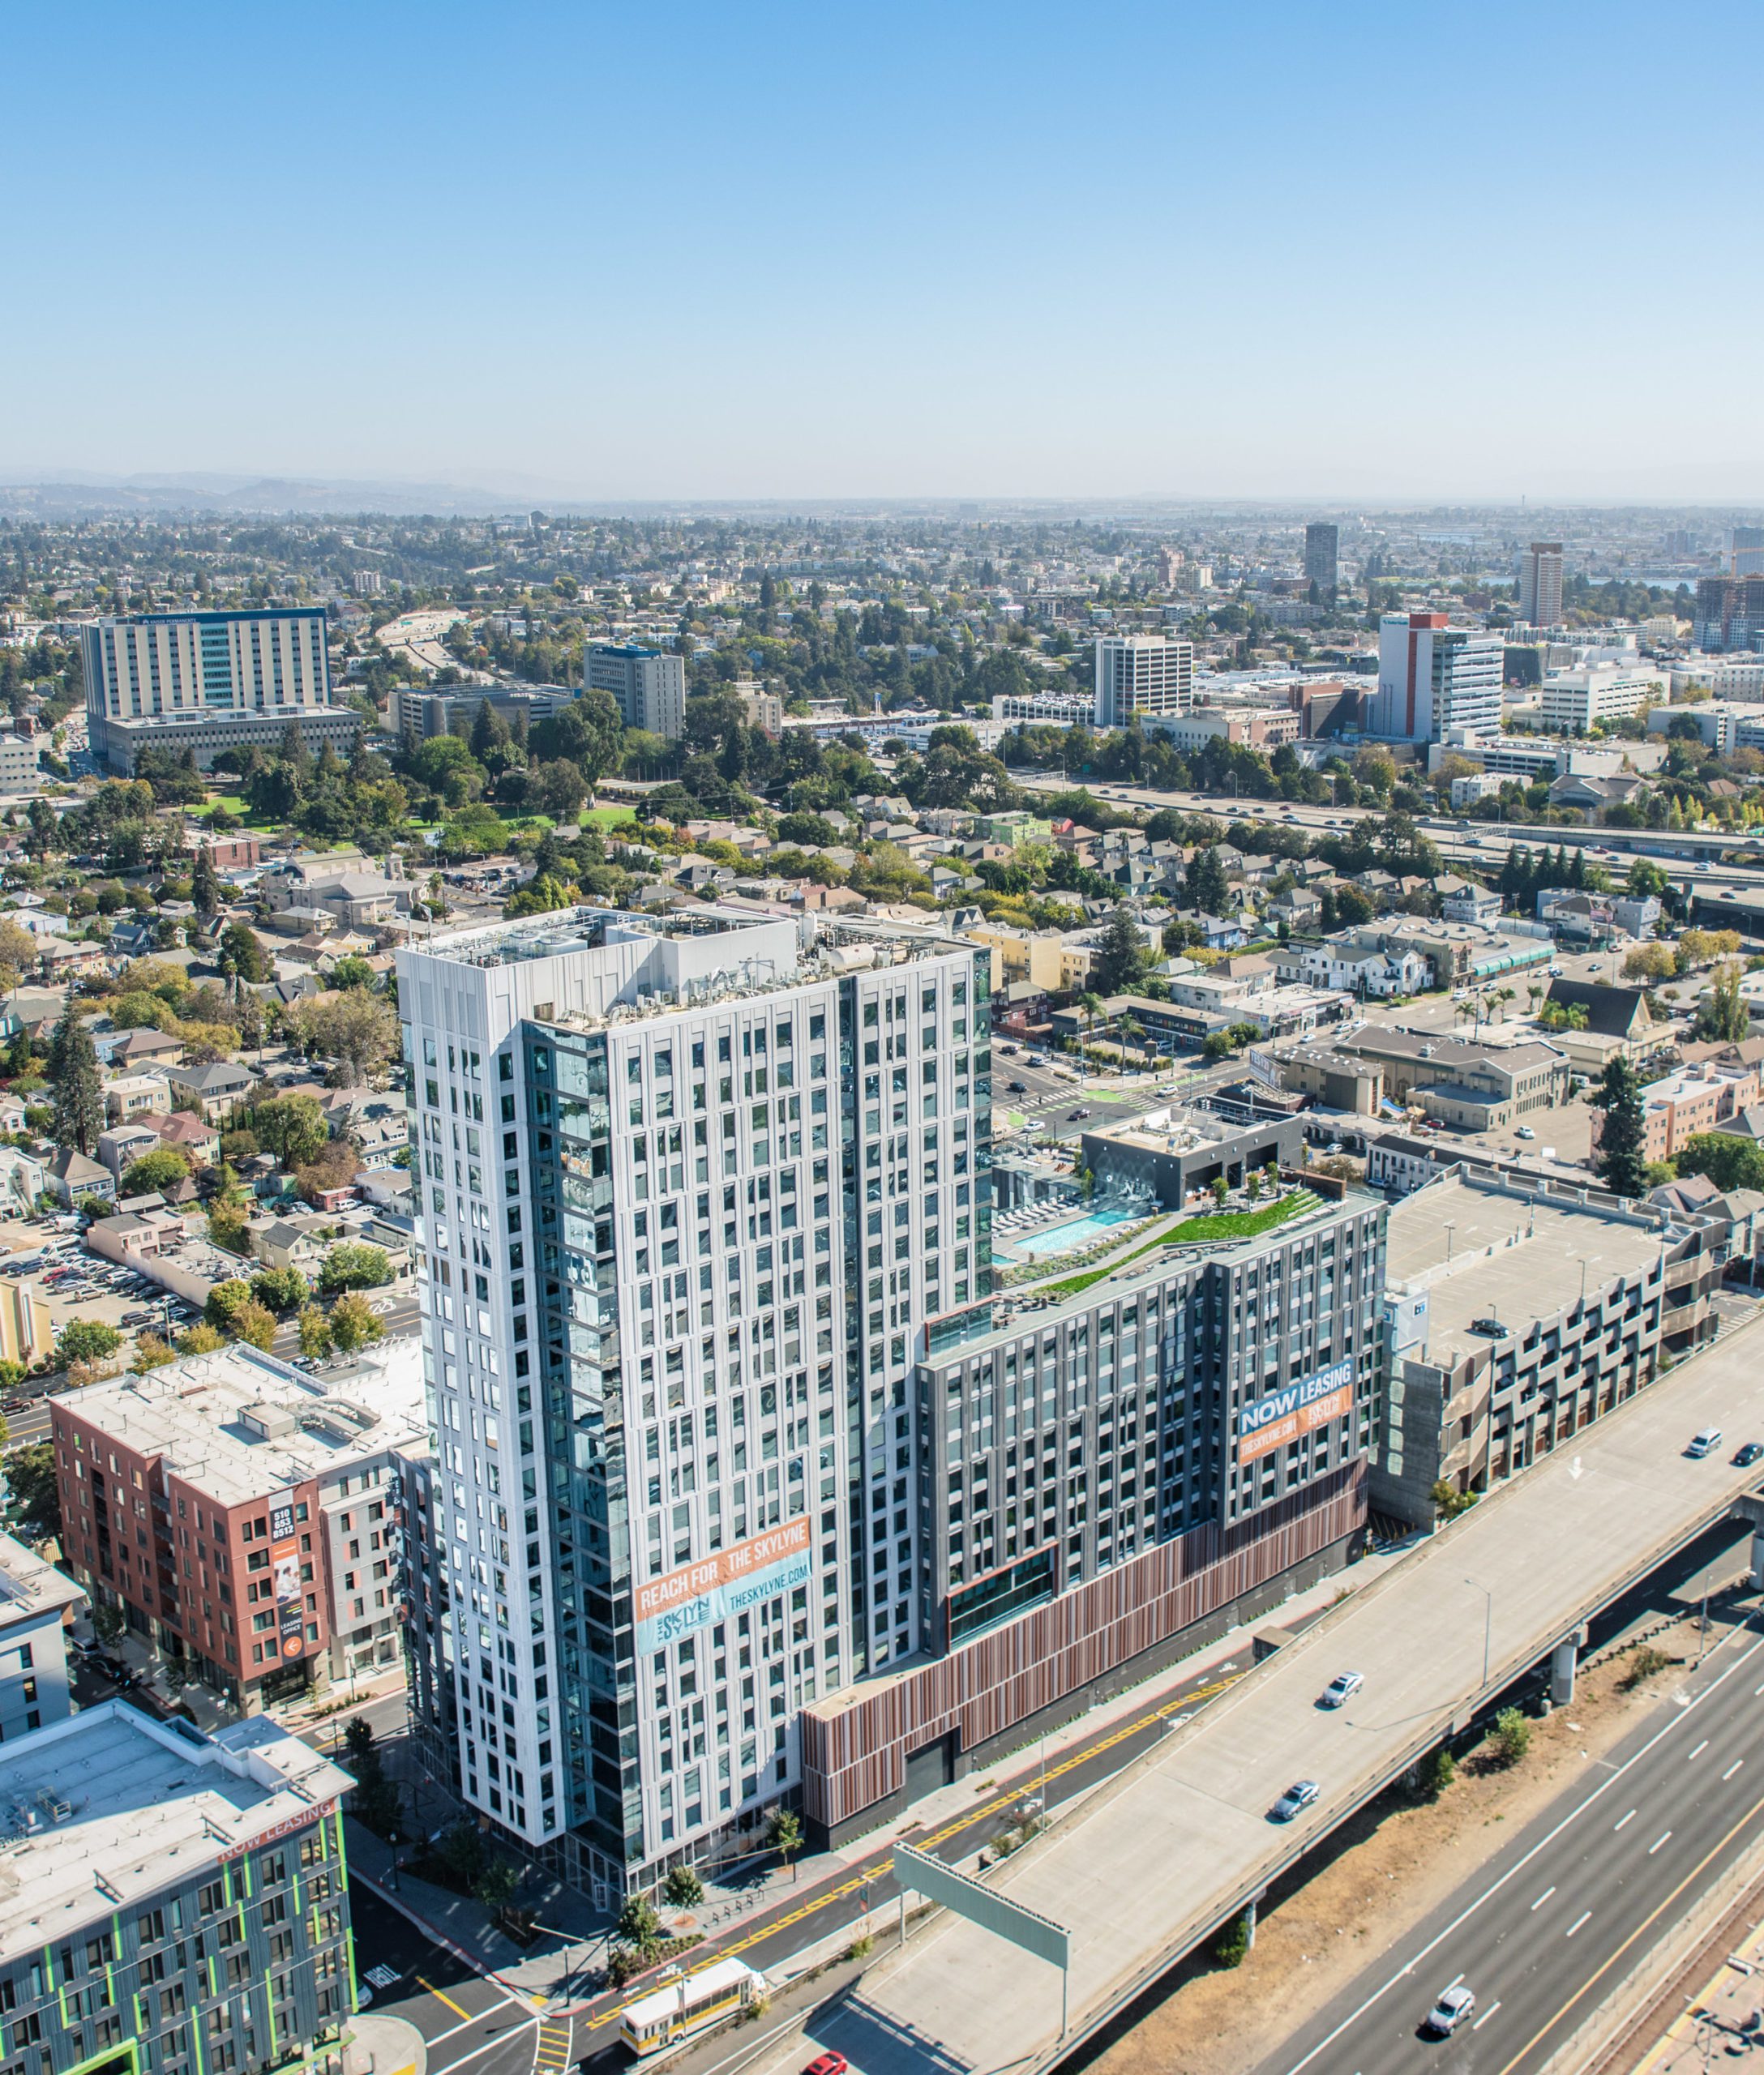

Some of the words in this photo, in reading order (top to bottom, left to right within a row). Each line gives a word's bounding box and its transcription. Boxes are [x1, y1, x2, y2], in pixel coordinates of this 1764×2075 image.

[1241, 1388, 1297, 1433] NOW
[1299, 1363, 1351, 1405] LEASING
[274, 1508, 290, 1521] 510
[274, 1517, 291, 1530] 653
[272, 1525, 294, 1539] 8512
[640, 1576, 688, 1611] REACH
[691, 1560, 717, 1589] FOR
[727, 1547, 752, 1573] THE
[753, 1522, 807, 1561] SKYLYNE
[730, 1564, 808, 1611] THESKYLYNE.COM
[280, 1617, 302, 1630] LEASING
[283, 1624, 301, 1635] OFFICE
[220, 1836, 260, 1861] NOW
[266, 1801, 331, 1839] LEASING
